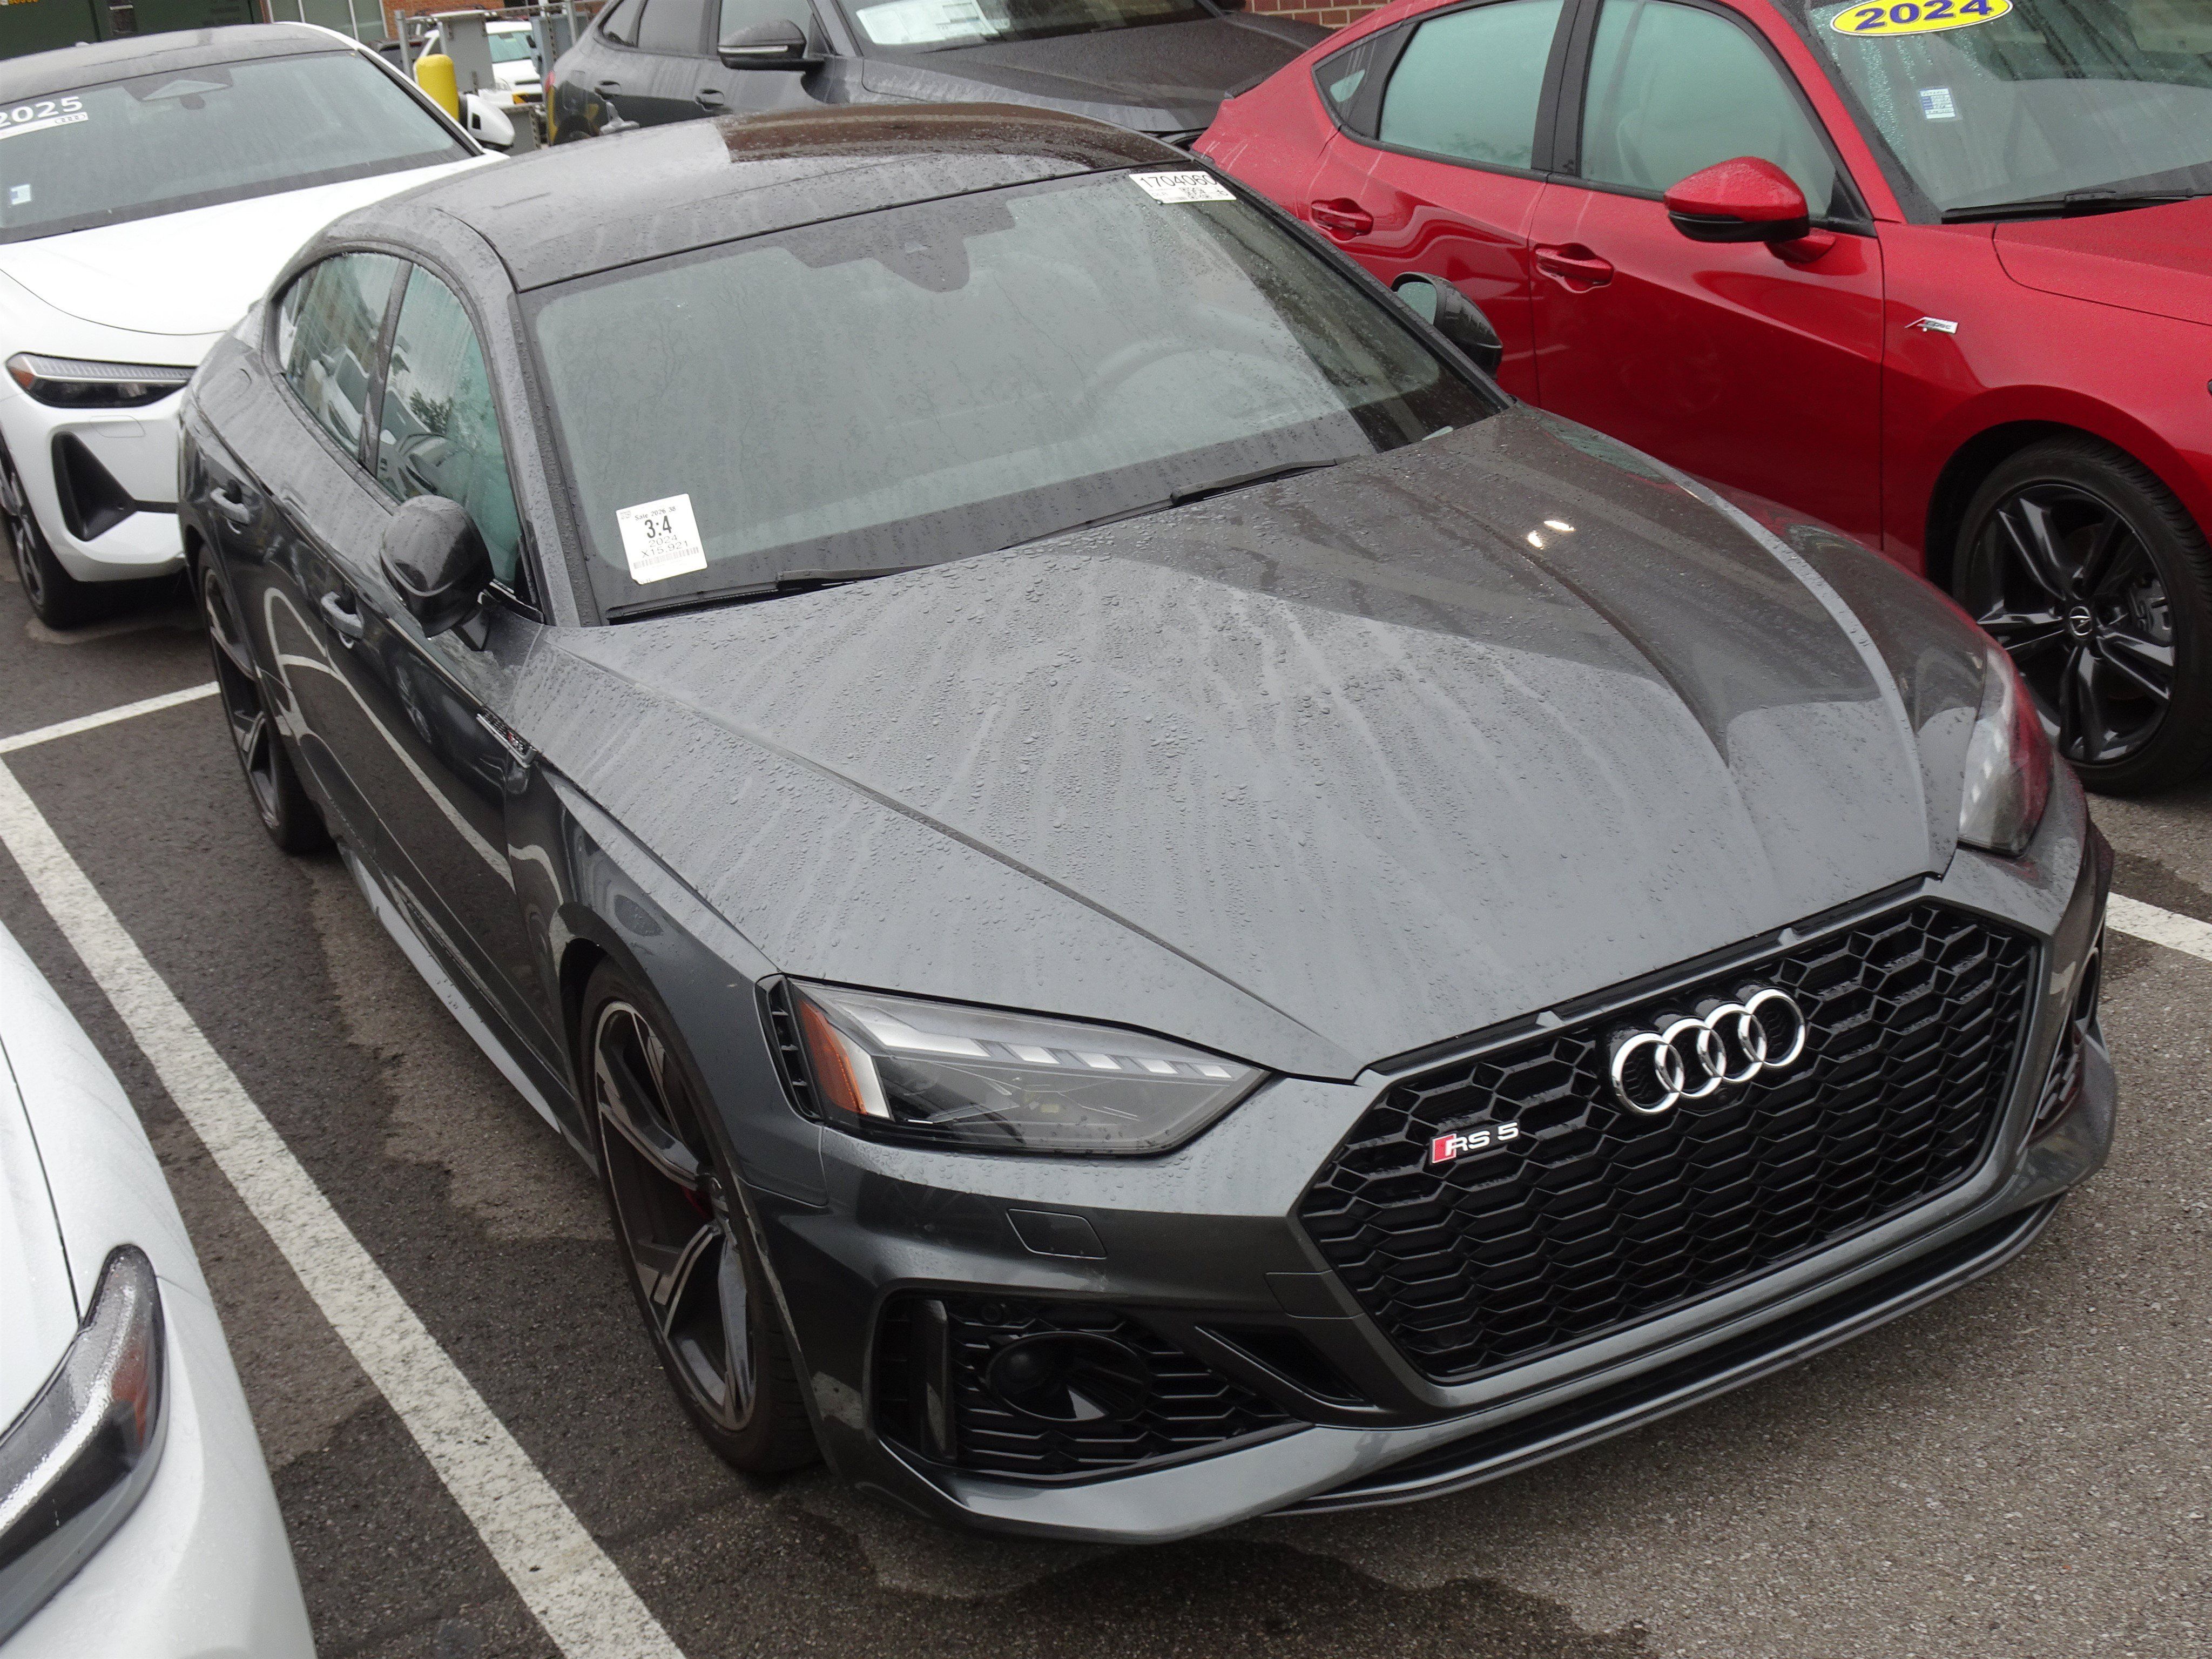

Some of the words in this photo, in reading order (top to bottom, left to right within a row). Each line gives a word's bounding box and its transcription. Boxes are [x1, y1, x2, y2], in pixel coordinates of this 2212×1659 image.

[1854, 0, 1994, 31] 2024
[644, 515, 672, 538] 3:4
[649, 535, 677, 547] 2024
[1445, 1130, 1491, 1157] RS
[1497, 1122, 1519, 1141] 5
